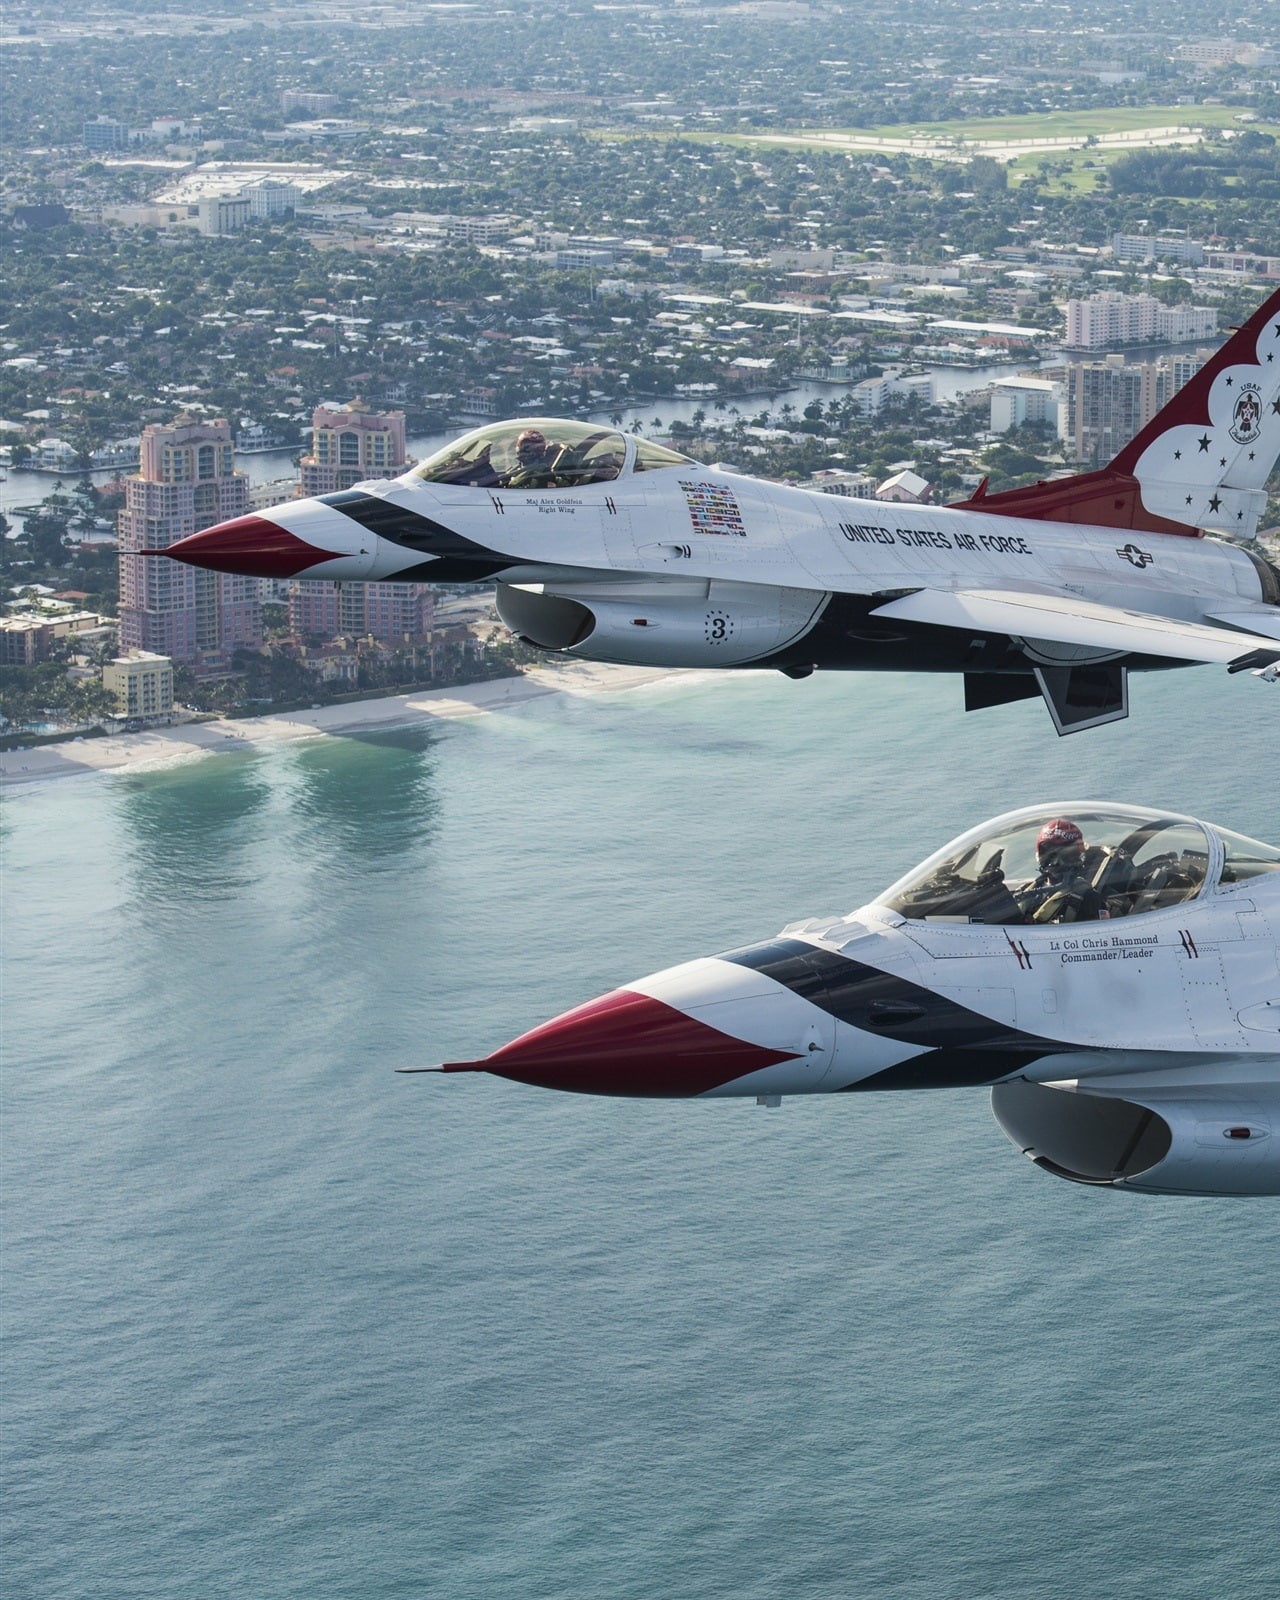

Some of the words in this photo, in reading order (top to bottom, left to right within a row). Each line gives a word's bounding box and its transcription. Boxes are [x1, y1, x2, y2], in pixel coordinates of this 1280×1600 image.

[1240, 382, 1262, 392] USAF
[526, 498, 538, 506] Maj
[538, 506, 556, 514] Right
[558, 506, 575, 514] Wing
[838, 523, 895, 545] UNITED
[896, 528, 953, 549] STATES
[953, 533, 982, 552] AIR
[978, 535, 1033, 555] FORCE
[711, 618, 726, 639] 3
[1050, 941, 1060, 951] Lt
[1063, 939, 1079, 950] Col
[1082, 937, 1108, 949] Chris
[1111, 934, 1159, 947] Hammond
[1061, 948, 1154, 963] Commander/Leader
